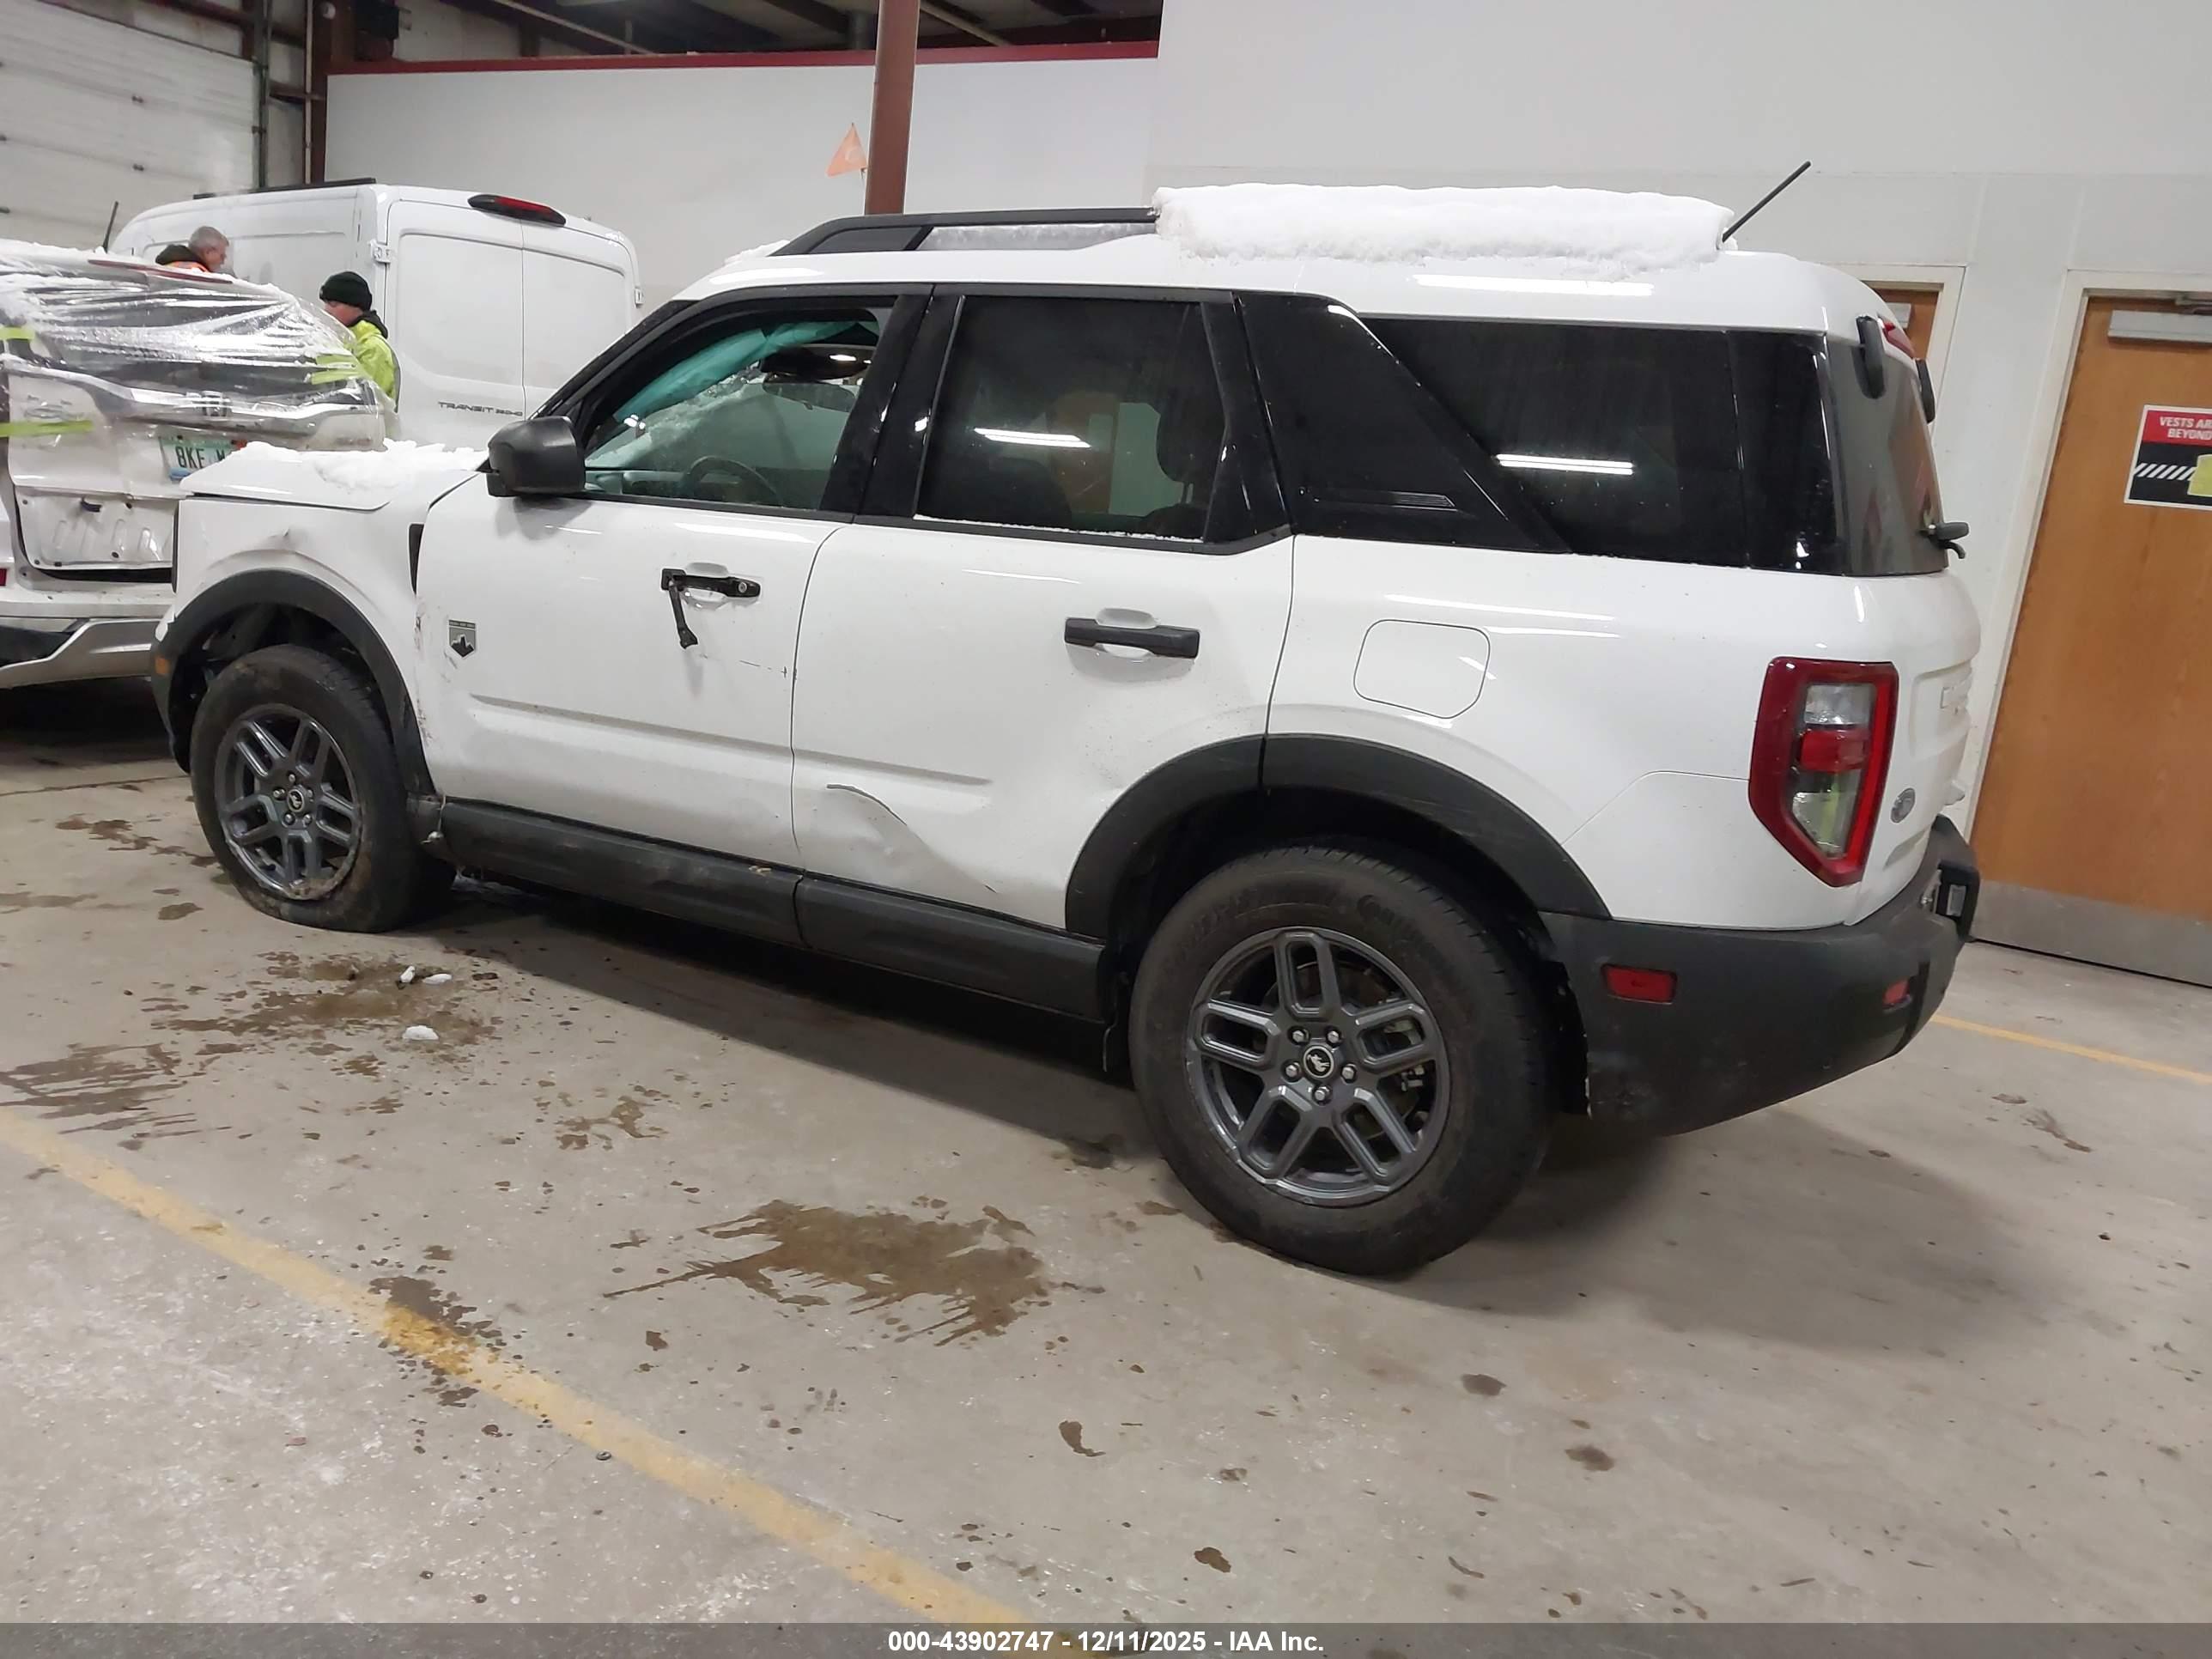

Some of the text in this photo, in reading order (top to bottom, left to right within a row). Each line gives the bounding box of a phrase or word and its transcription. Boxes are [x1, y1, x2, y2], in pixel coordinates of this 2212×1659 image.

[438, 402, 494, 412] TRANSIT
[2160, 416, 2194, 428] VESTS
[2167, 428, 2212, 440] BEYOND
